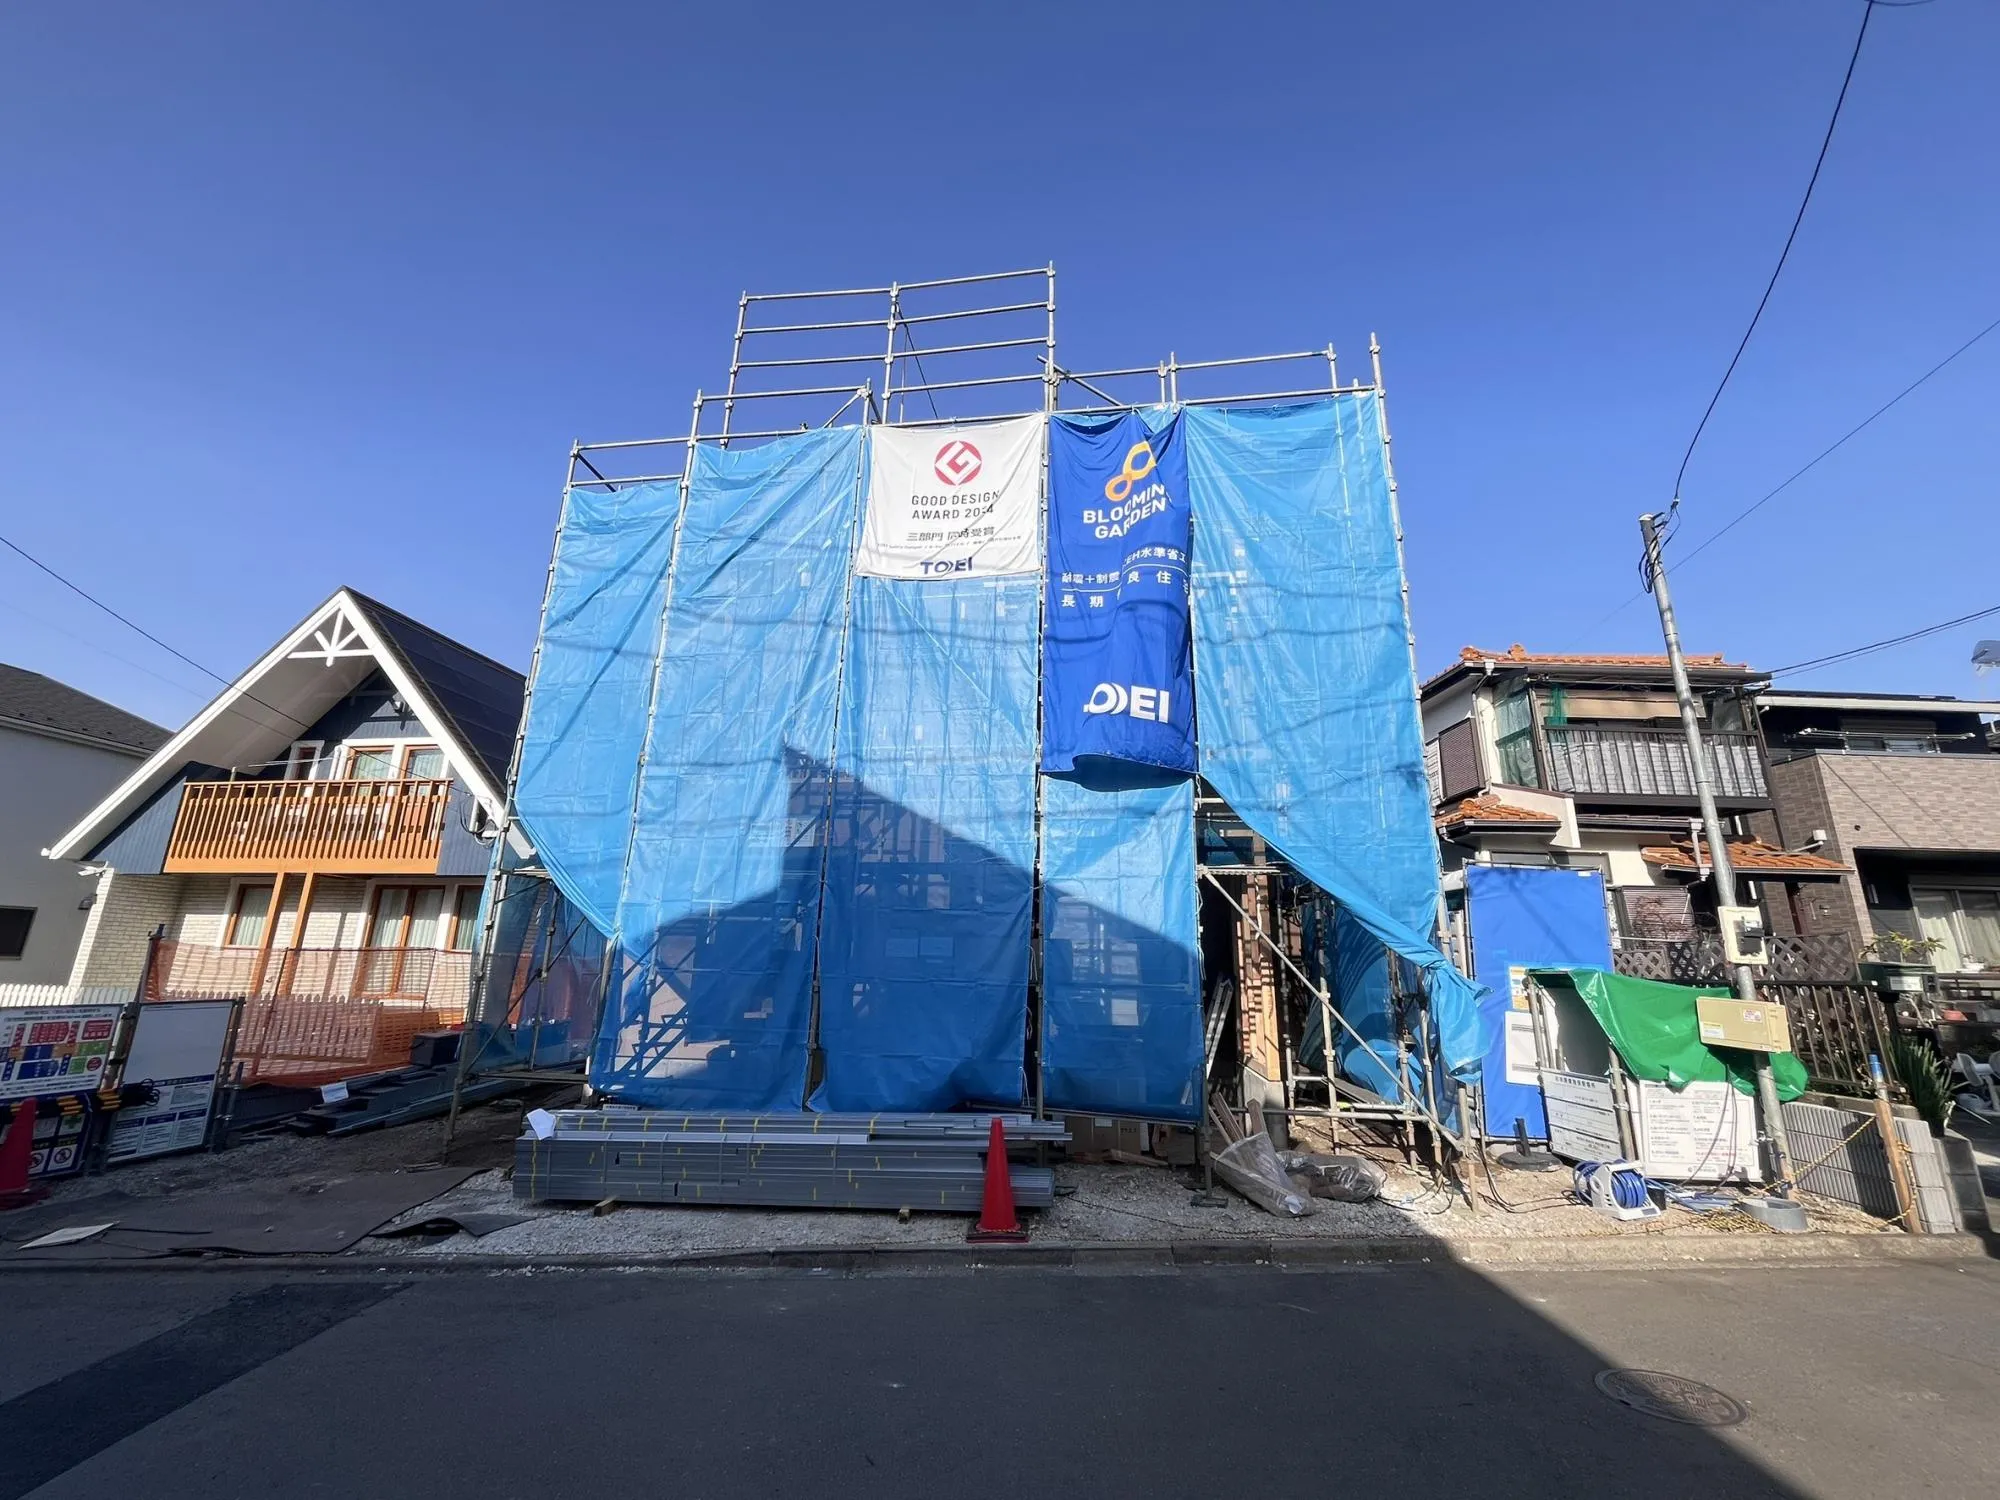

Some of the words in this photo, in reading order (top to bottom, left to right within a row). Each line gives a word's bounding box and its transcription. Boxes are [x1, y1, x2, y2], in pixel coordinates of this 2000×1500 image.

[911, 495, 947, 506] GOOD
[951, 490, 1000, 505] DESIGN
[912, 507, 960, 520] AWARD
[1094, 497, 1166, 539] GARDEN
[906, 531, 944, 542] 三部門
[1083, 681, 1170, 724] OEI
